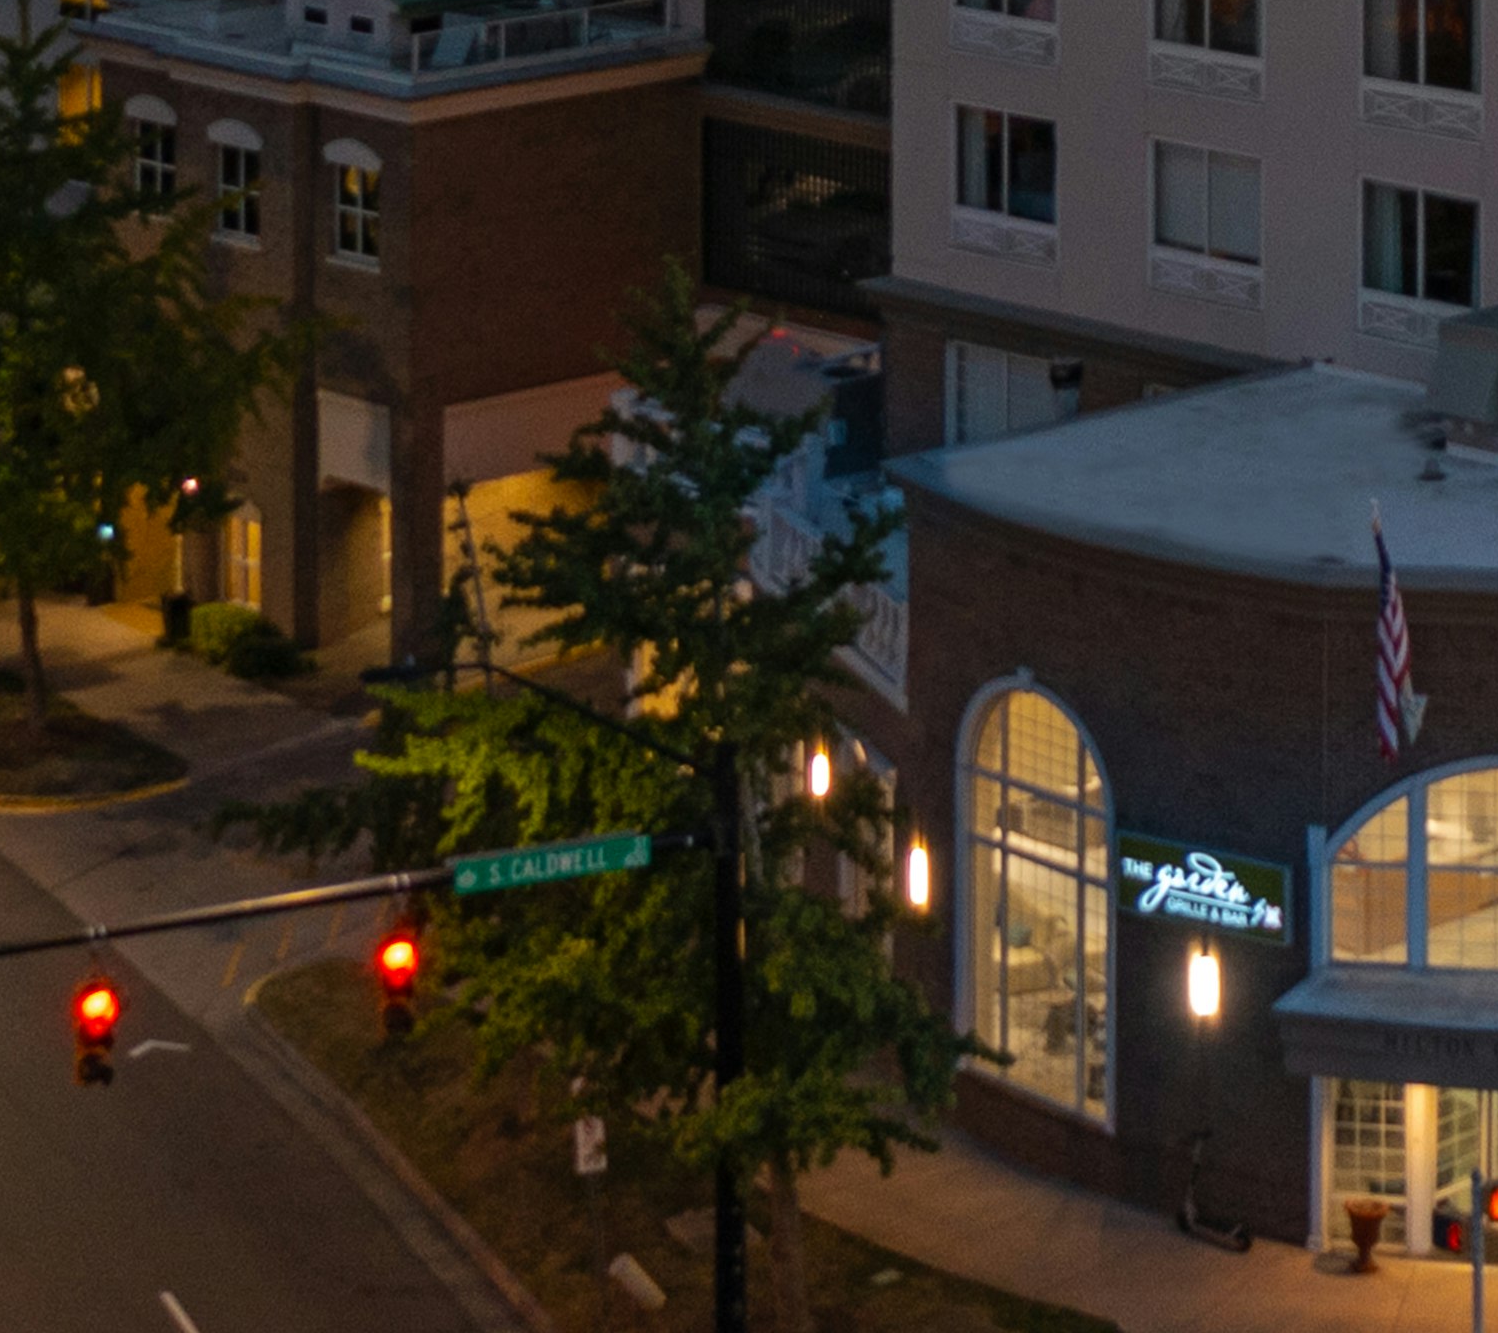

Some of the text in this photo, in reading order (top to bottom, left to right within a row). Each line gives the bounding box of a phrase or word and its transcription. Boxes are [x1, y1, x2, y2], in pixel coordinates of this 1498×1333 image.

[511, 847, 606, 882] CALDWELL
[1120, 855, 1154, 882] THE
[1137, 851, 1252, 913] garden
